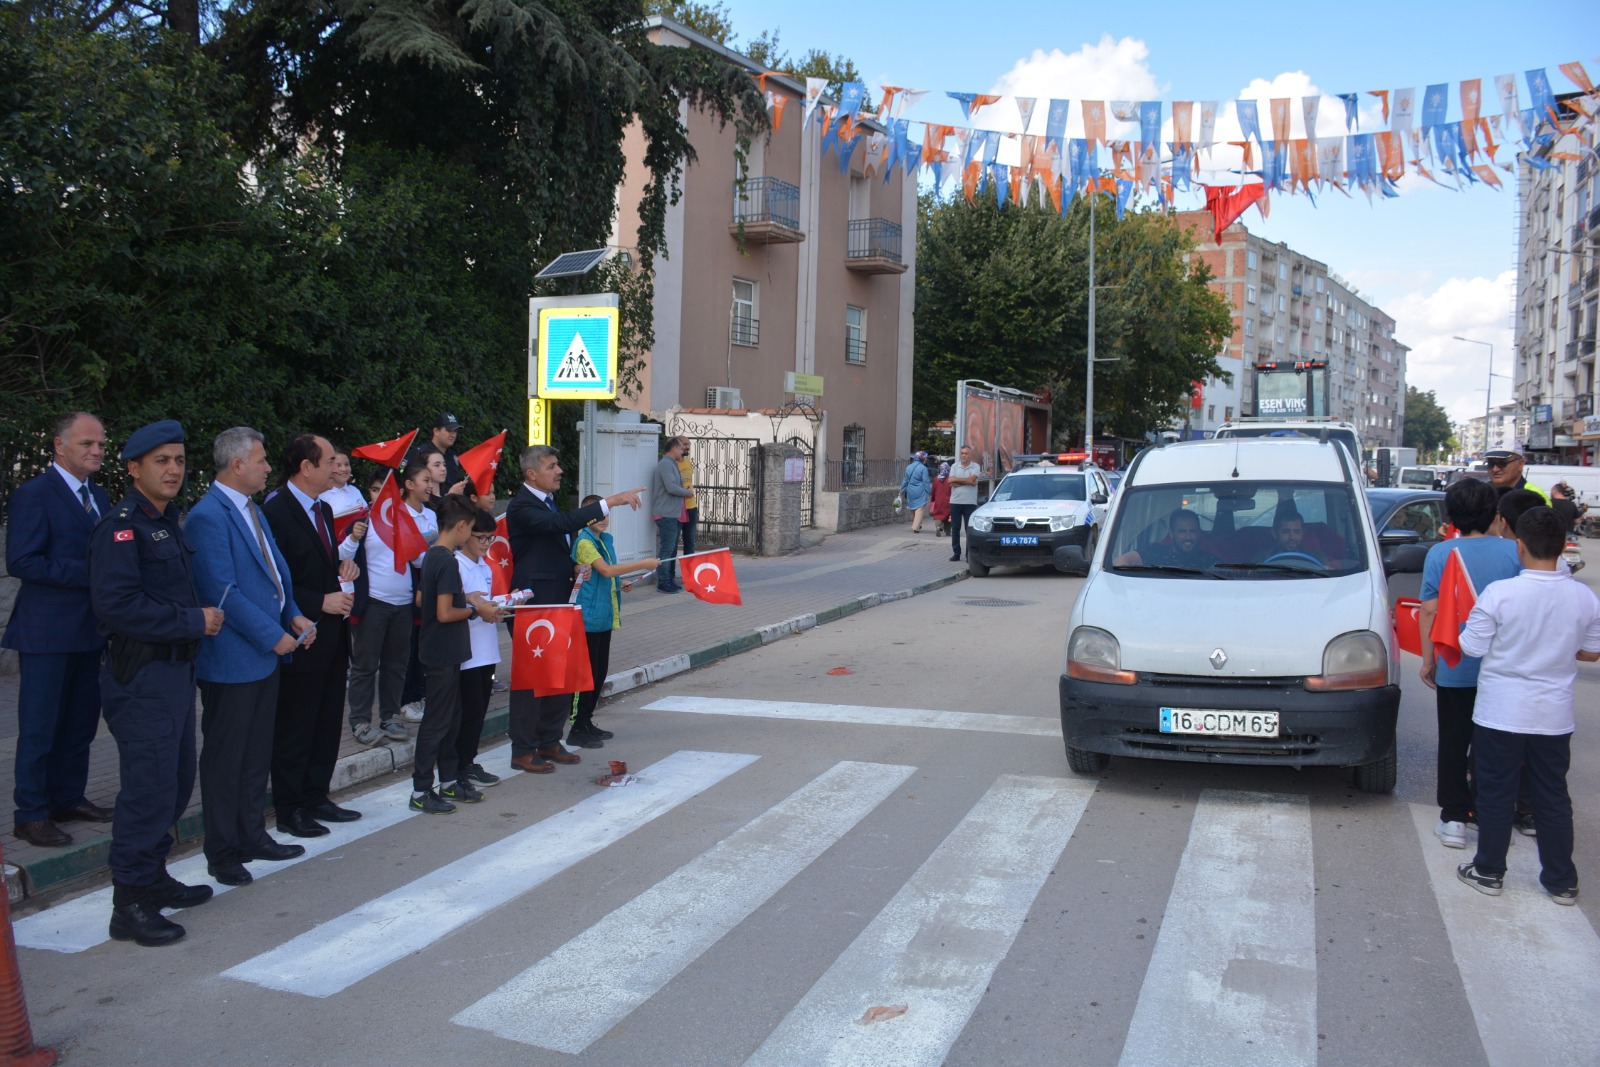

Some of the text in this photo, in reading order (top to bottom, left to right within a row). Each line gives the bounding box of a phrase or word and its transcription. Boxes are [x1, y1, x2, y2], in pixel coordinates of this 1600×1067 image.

[1260, 399, 1283, 409] ESEN
[1172, 712, 1275, 733] 16 CDM 65
